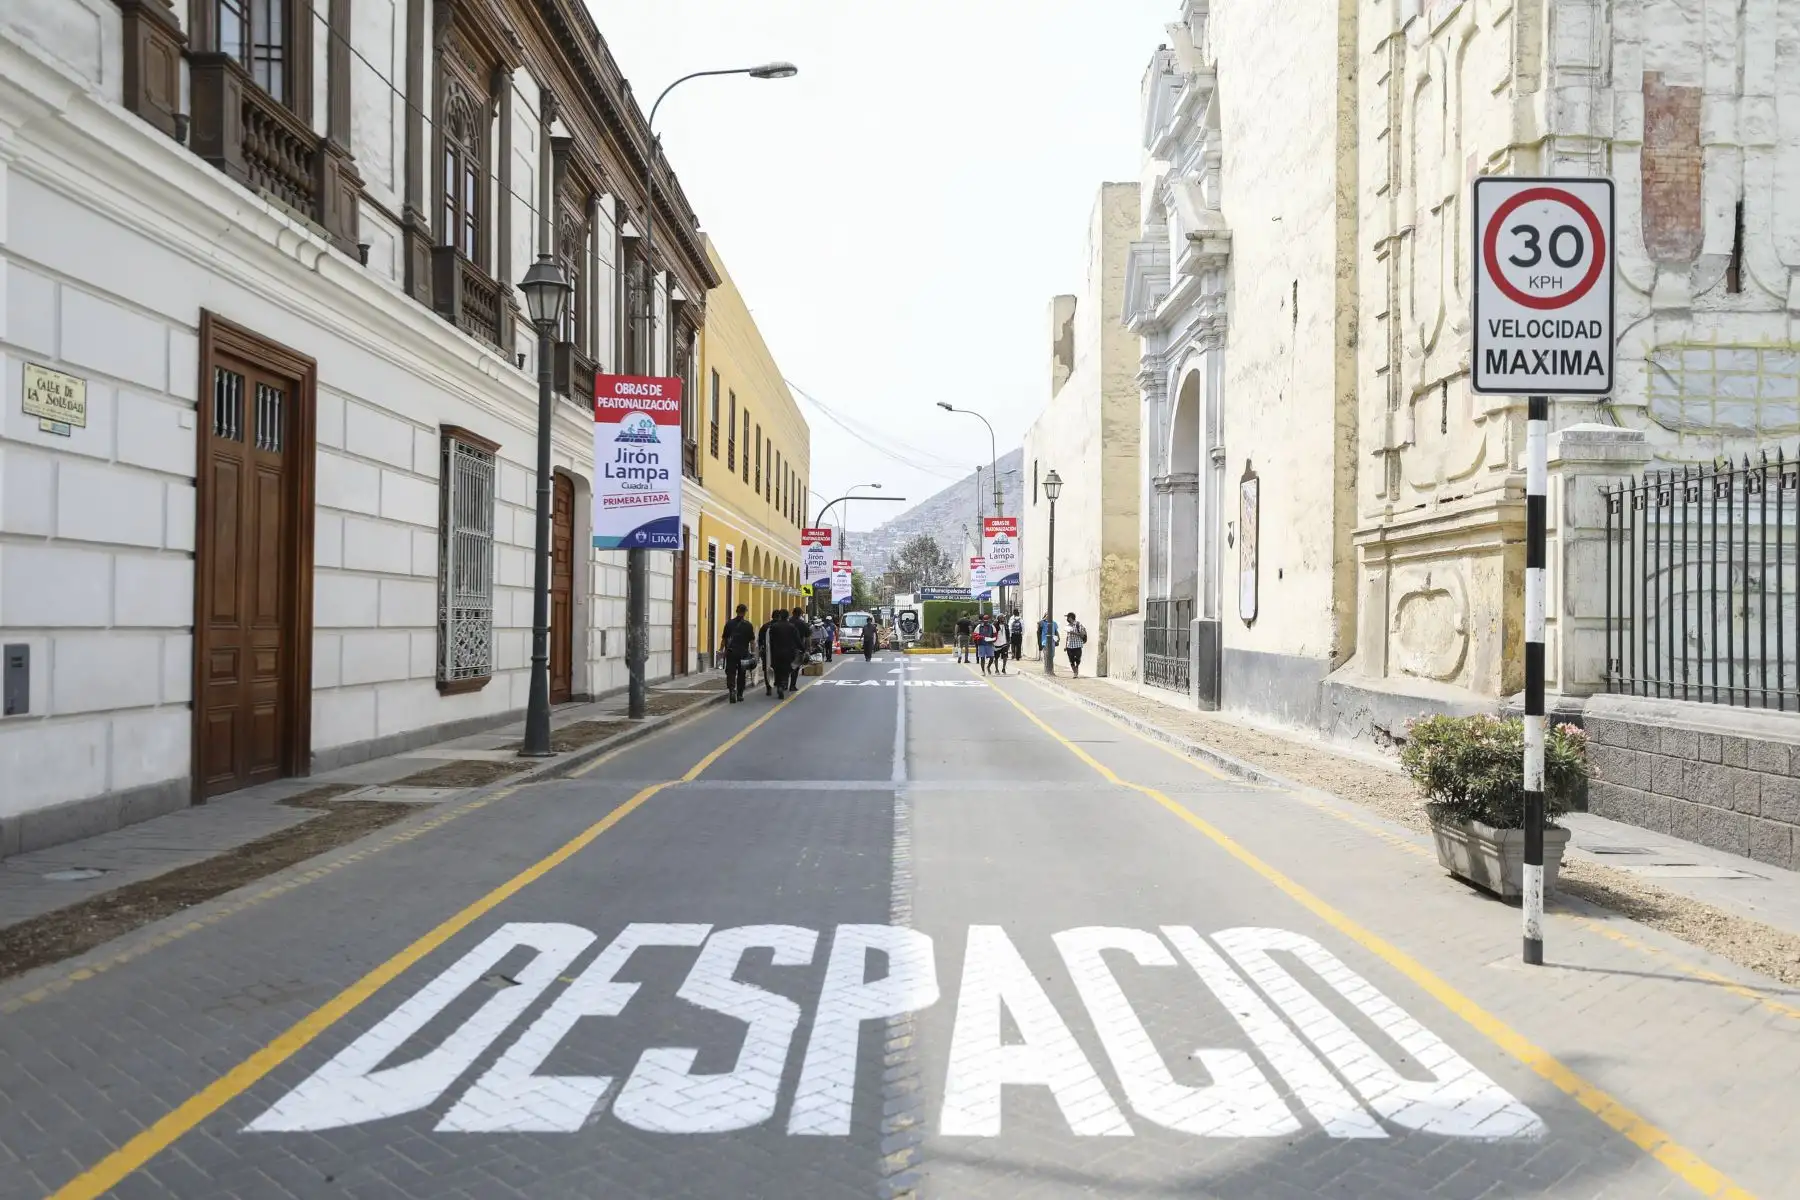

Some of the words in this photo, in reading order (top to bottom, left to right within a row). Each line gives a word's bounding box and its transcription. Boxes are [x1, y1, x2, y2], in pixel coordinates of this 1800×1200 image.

[1508, 224, 1585, 269] 30
[1529, 275, 1563, 290] KPH
[1488, 318, 1603, 339] VELOCIDAD
[1486, 348, 1605, 376] MAXIMA
[614, 382, 648, 396] OBRAS
[649, 384, 663, 397] DE
[45, 392, 84, 414] SOLEDAD
[597, 396, 679, 411] PEATONALIZACIÓN
[614, 447, 659, 465] Jirón
[605, 462, 669, 483] Lampa
[621, 481, 649, 490] Cuadra
[603, 496, 642, 506] PRIMERA
[643, 494, 670, 503] ETAPA
[651, 535, 678, 544] LIMA
[813, 679, 989, 687] PEATONES
[240, 920, 1548, 1138] DESPACIO
